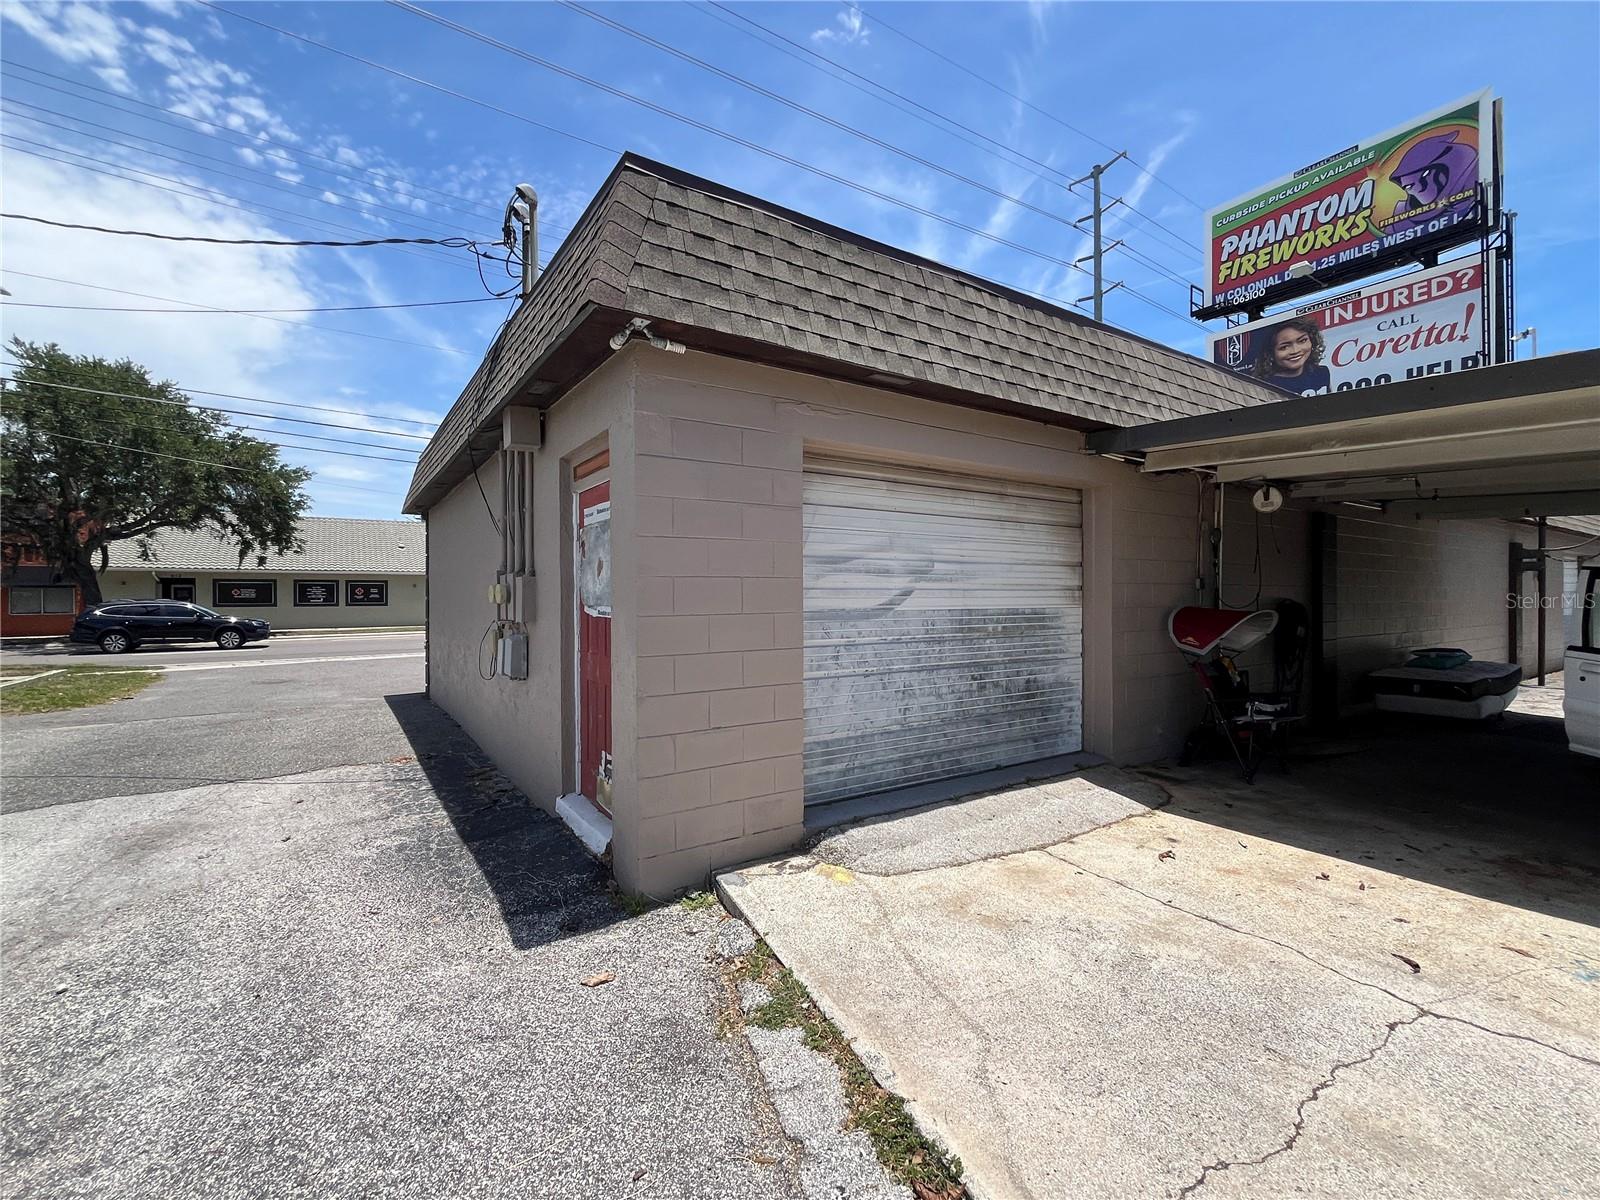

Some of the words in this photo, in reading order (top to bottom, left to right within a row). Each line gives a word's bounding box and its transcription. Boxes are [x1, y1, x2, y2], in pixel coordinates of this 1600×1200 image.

[1216, 200, 1265, 228] CURBSIDE
[1268, 181, 1309, 205] PICKUP
[1312, 150, 1376, 185] AVAILABLE
[1221, 179, 1374, 262] PHANTOM
[1380, 204, 1436, 227] FIREWORKS
[1215, 292, 1225, 304] W
[1227, 274, 1282, 300] COLONIAL
[1311, 255, 1336, 271] 1.25
[1339, 240, 1380, 263] MILES
[1383, 225, 1425, 248] WEST
[1428, 216, 1449, 233] OF
[1218, 208, 1371, 284] FIREWORKS
[1324, 268, 1475, 327] INJURED?
[1376, 314, 1420, 332] CALL
[1331, 302, 1476, 368] Coretta!
